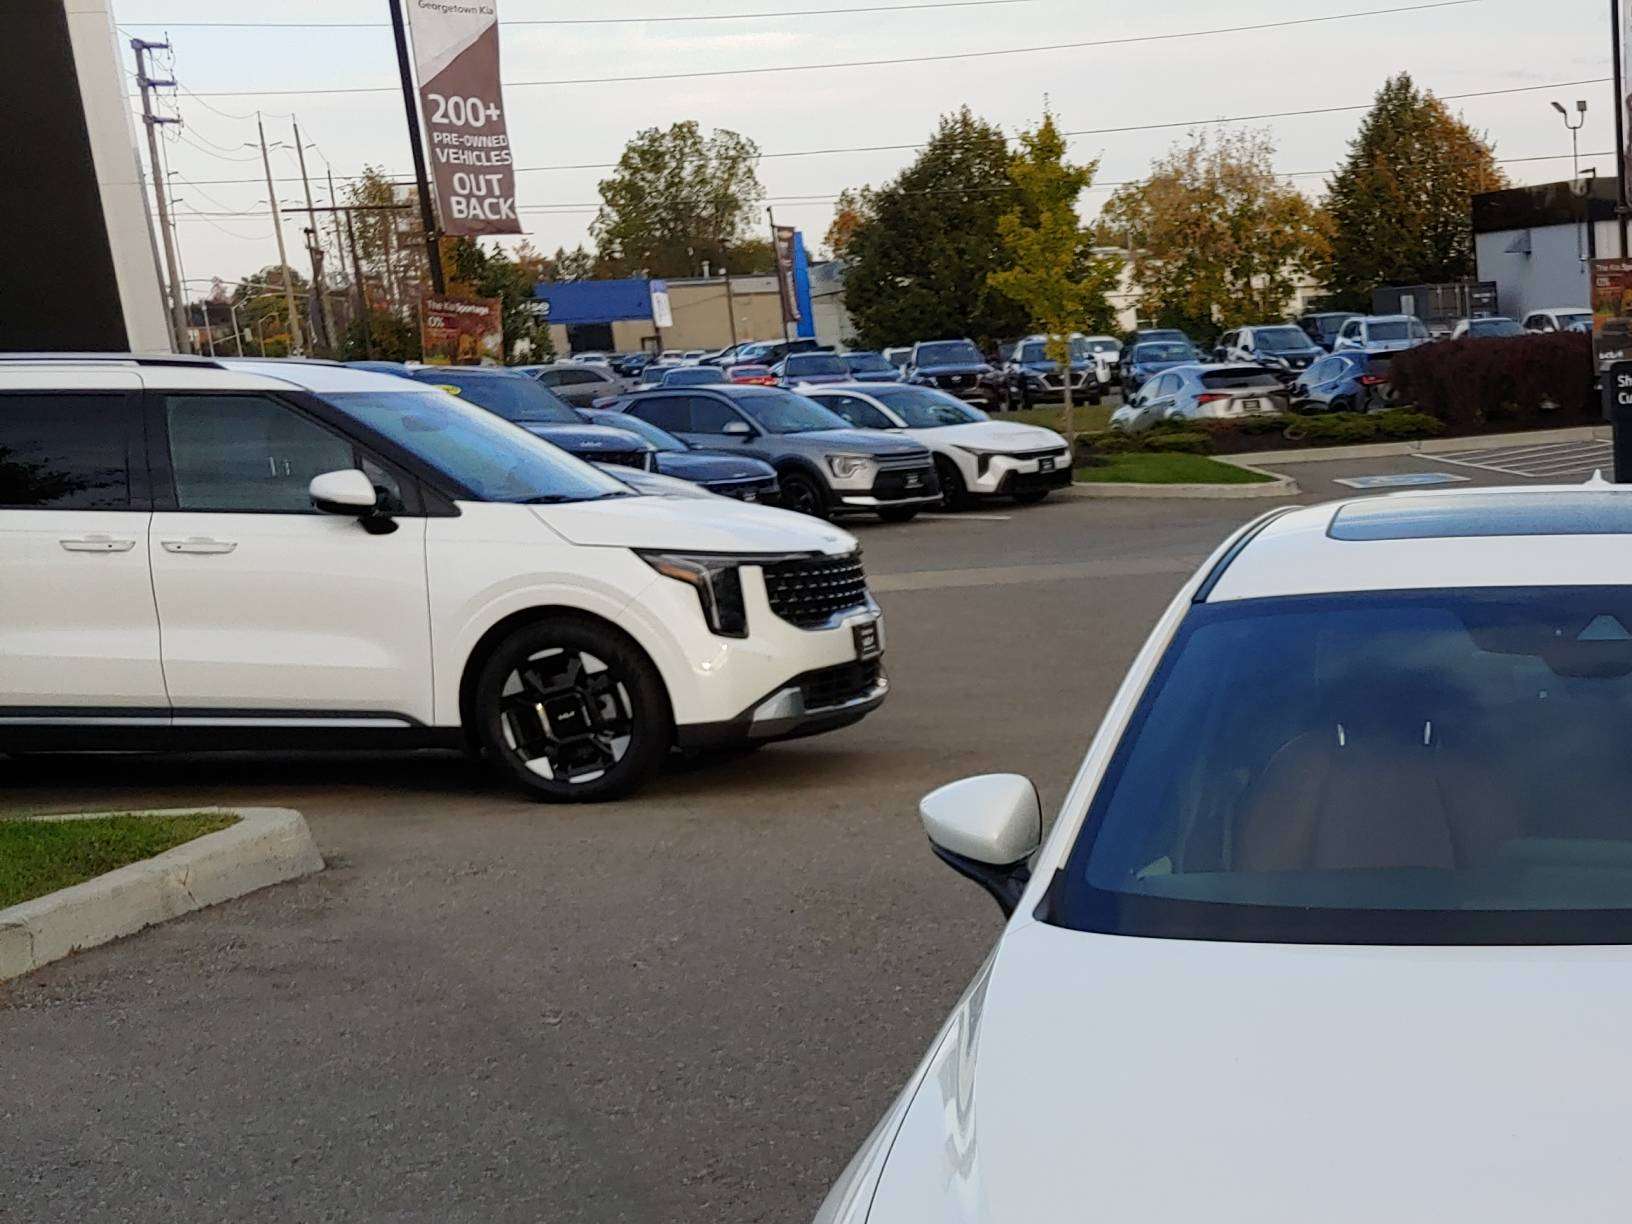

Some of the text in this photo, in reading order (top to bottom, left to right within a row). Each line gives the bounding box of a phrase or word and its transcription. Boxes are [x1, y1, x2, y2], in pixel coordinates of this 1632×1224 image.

[428, 94, 501, 128] 200+
[433, 132, 509, 148] PRE-OWNED
[435, 147, 513, 167] VEHICLES
[452, 172, 503, 197] OUT
[450, 196, 517, 220] BACK
